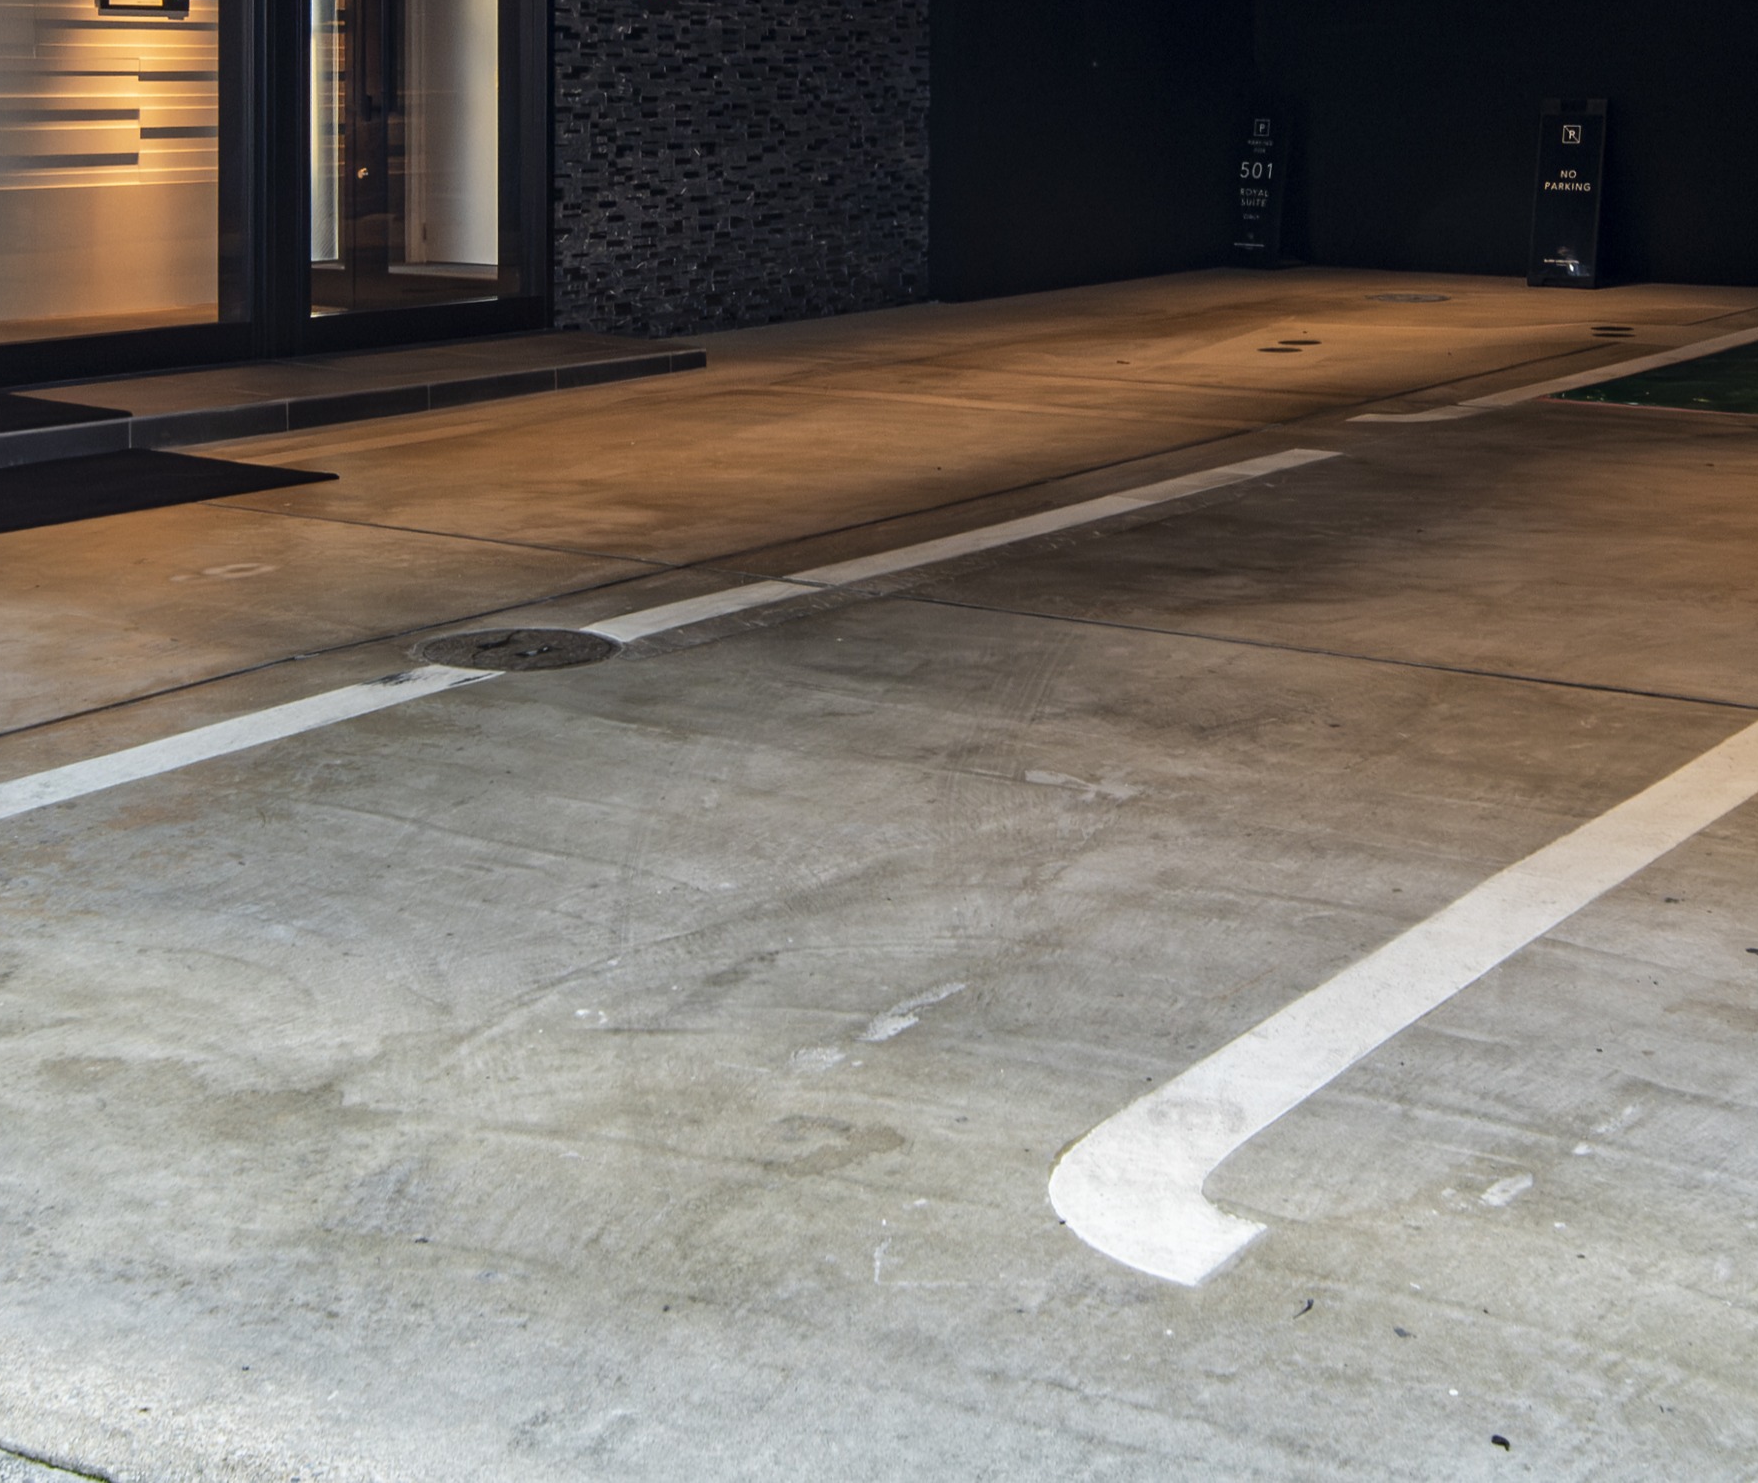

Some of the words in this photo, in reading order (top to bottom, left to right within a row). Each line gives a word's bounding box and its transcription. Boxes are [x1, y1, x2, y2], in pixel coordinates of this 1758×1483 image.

[1239, 161, 1274, 180] 501
[1559, 169, 1578, 180] NO
[1543, 181, 1592, 193] PARKING
[1240, 198, 1268, 208] SUITE
